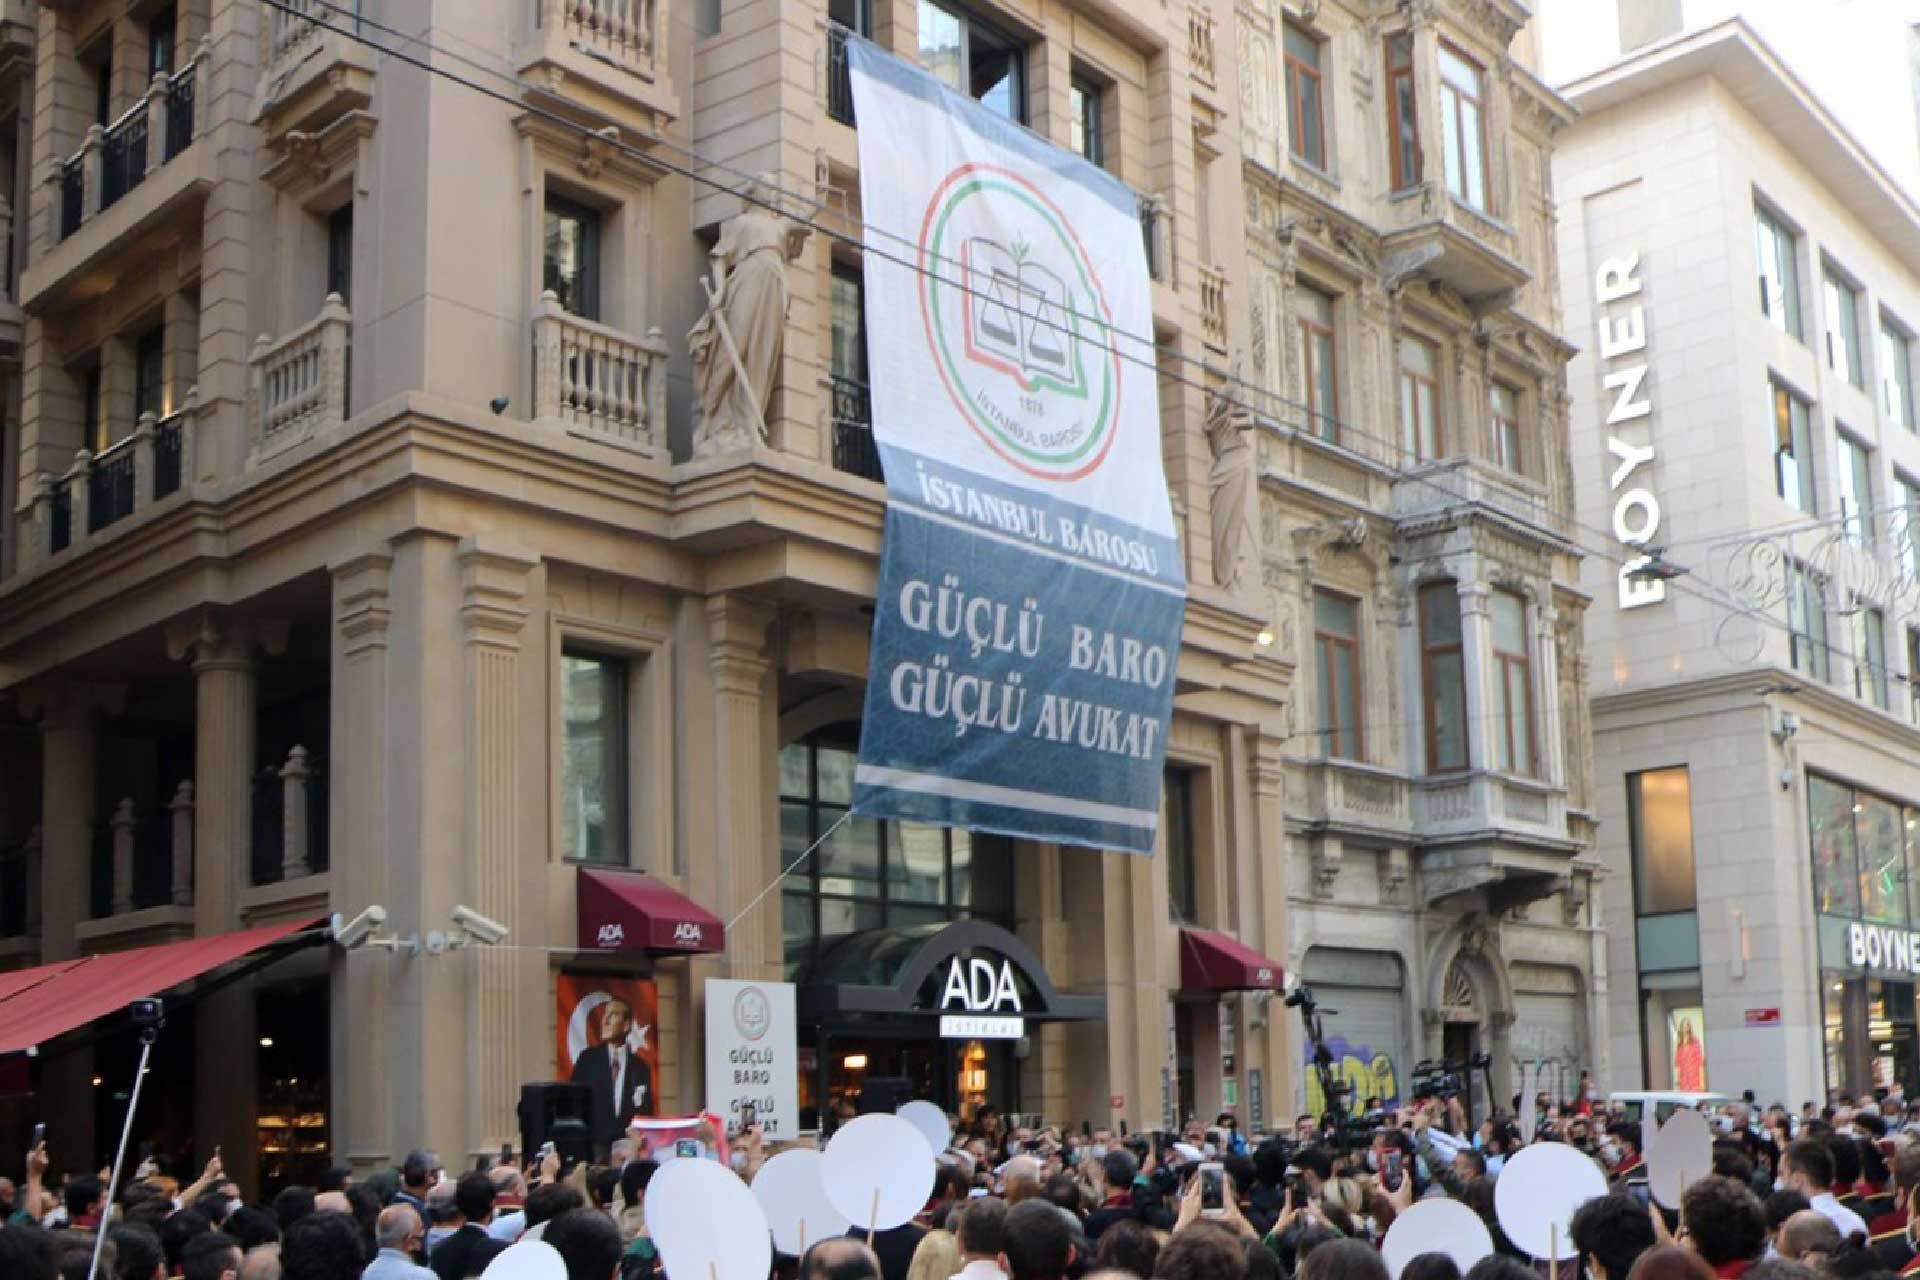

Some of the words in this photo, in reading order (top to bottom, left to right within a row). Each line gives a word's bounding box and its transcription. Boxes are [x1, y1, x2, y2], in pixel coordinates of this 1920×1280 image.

[916, 459, 1053, 544] İSTANBUL
[1058, 517, 1159, 577] BAROSU
[900, 573, 1044, 659] GÜÇLÜ
[1069, 623, 1166, 689] BARO
[890, 653, 1026, 737] GÜÇLÜ
[1032, 693, 1161, 760] AVUKAT
[673, 922, 703, 941] ADA
[941, 955, 1022, 1012] ADA
[729, 1046, 774, 1066] GÜÇLÜ
[733, 1069, 771, 1086] BARO
